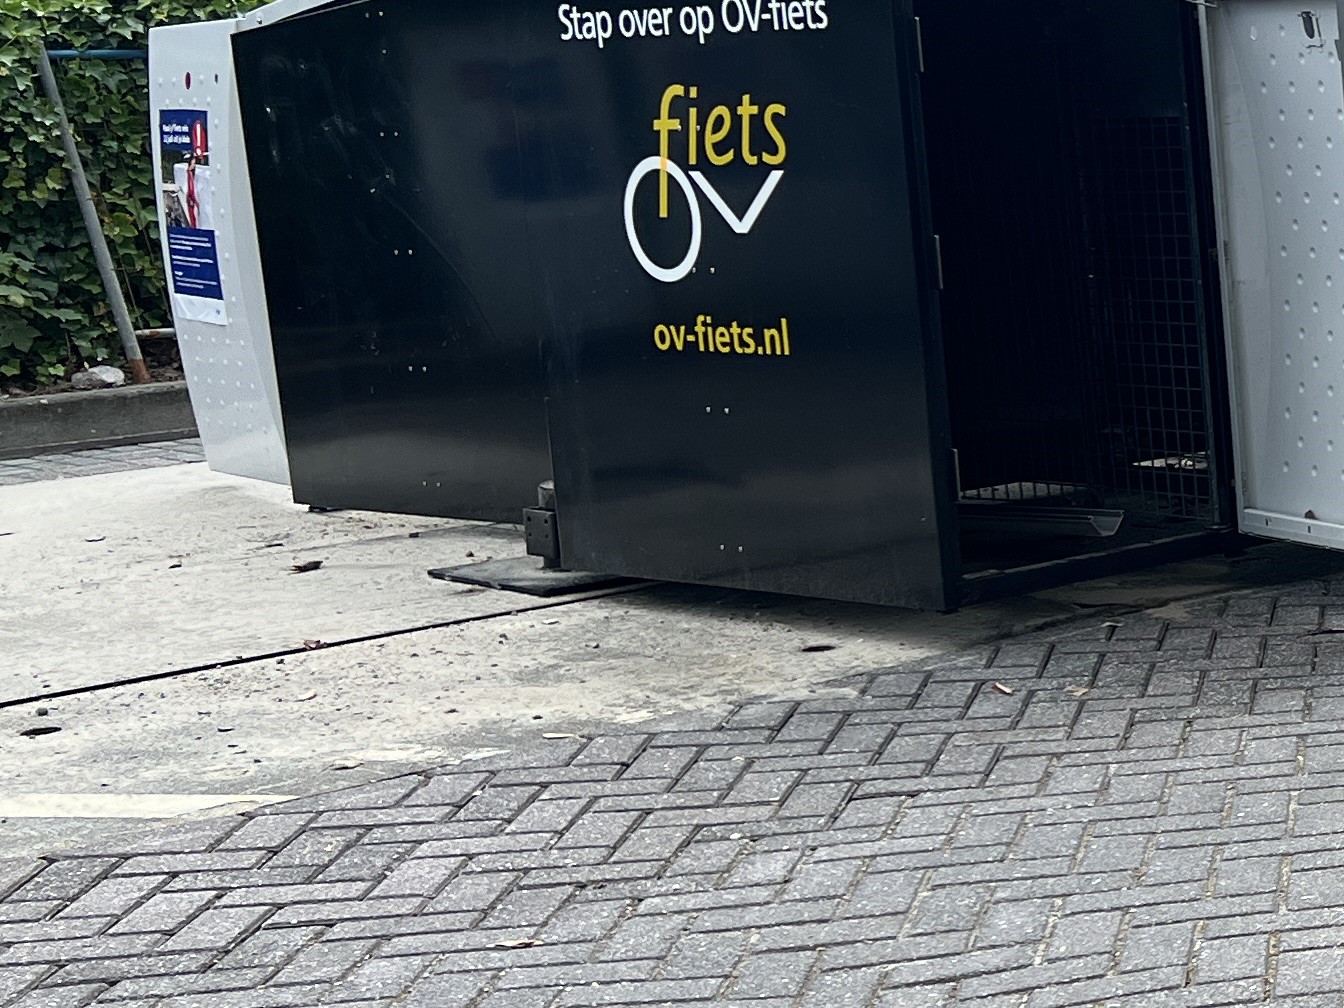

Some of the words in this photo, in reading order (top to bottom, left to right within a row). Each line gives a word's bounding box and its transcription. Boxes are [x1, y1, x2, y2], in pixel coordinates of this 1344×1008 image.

[558, 3, 613, 49] Stap
[618, 7, 673, 38] over
[679, 5, 714, 44] op
[653, 84, 788, 218] fiets
[623, 155, 784, 283] OV
[653, 314, 790, 356] ov-fiets.nl
